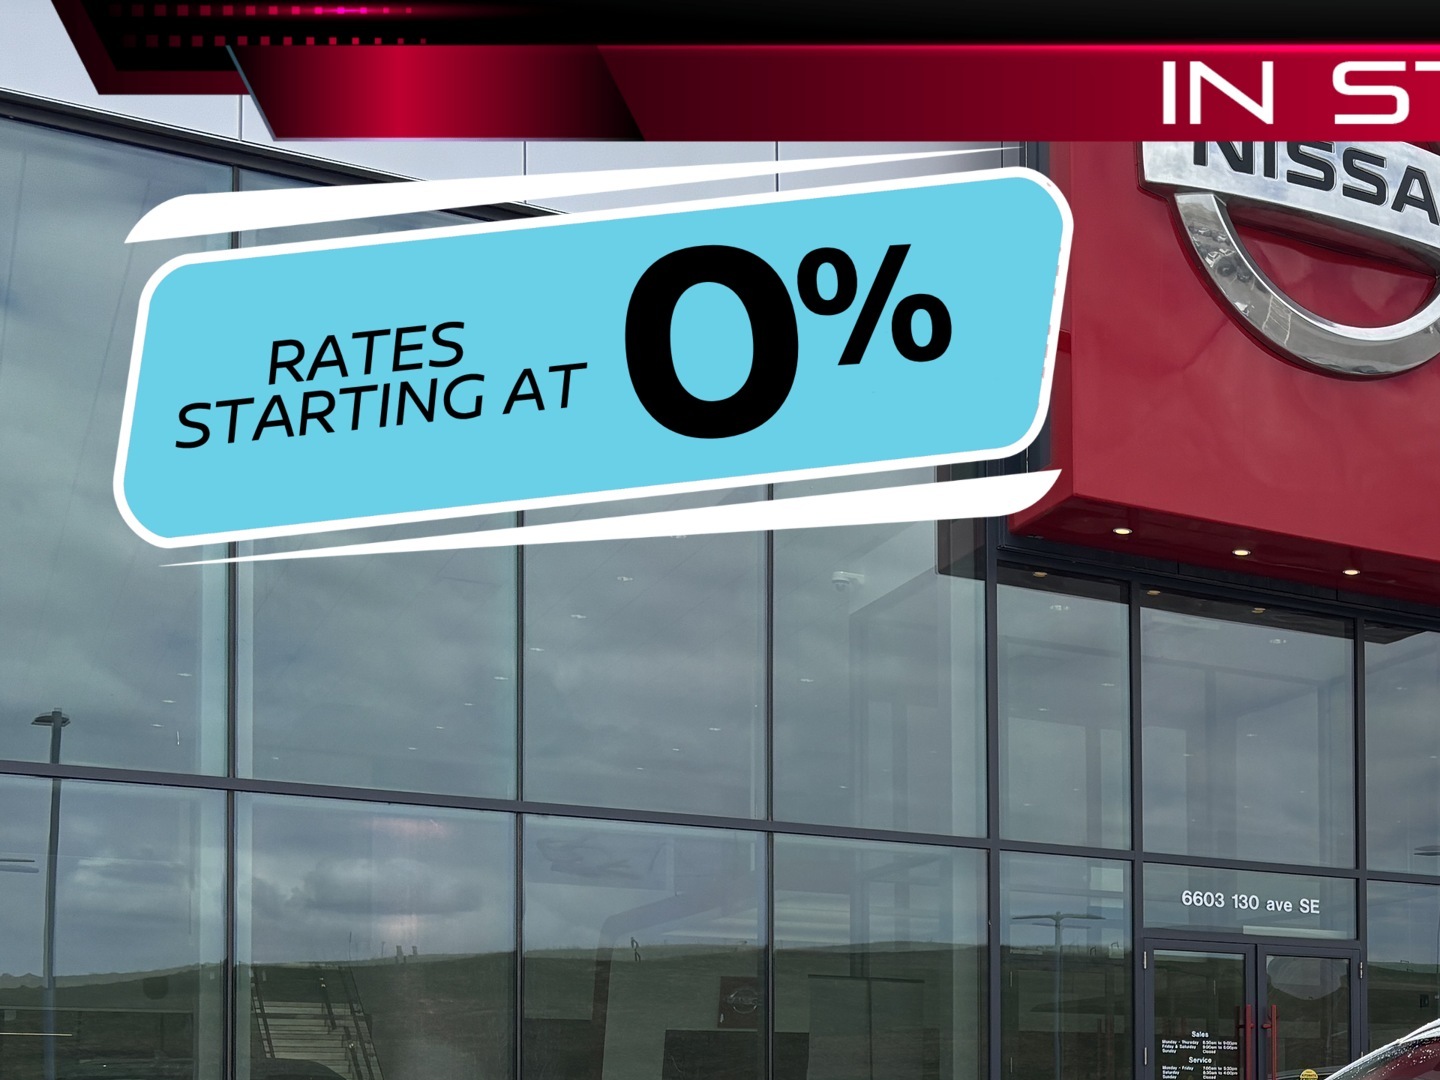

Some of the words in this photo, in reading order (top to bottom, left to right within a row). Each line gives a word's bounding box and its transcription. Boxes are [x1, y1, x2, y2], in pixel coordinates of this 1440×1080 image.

[1181, 889, 1225, 908] 6603
[1231, 893, 1260, 910] 130
[1266, 899, 1293, 912] ave
[1299, 898, 1320, 914] SE
[1191, 1030, 1209, 1038] Sales
[1188, 1056, 1212, 1064] Service
